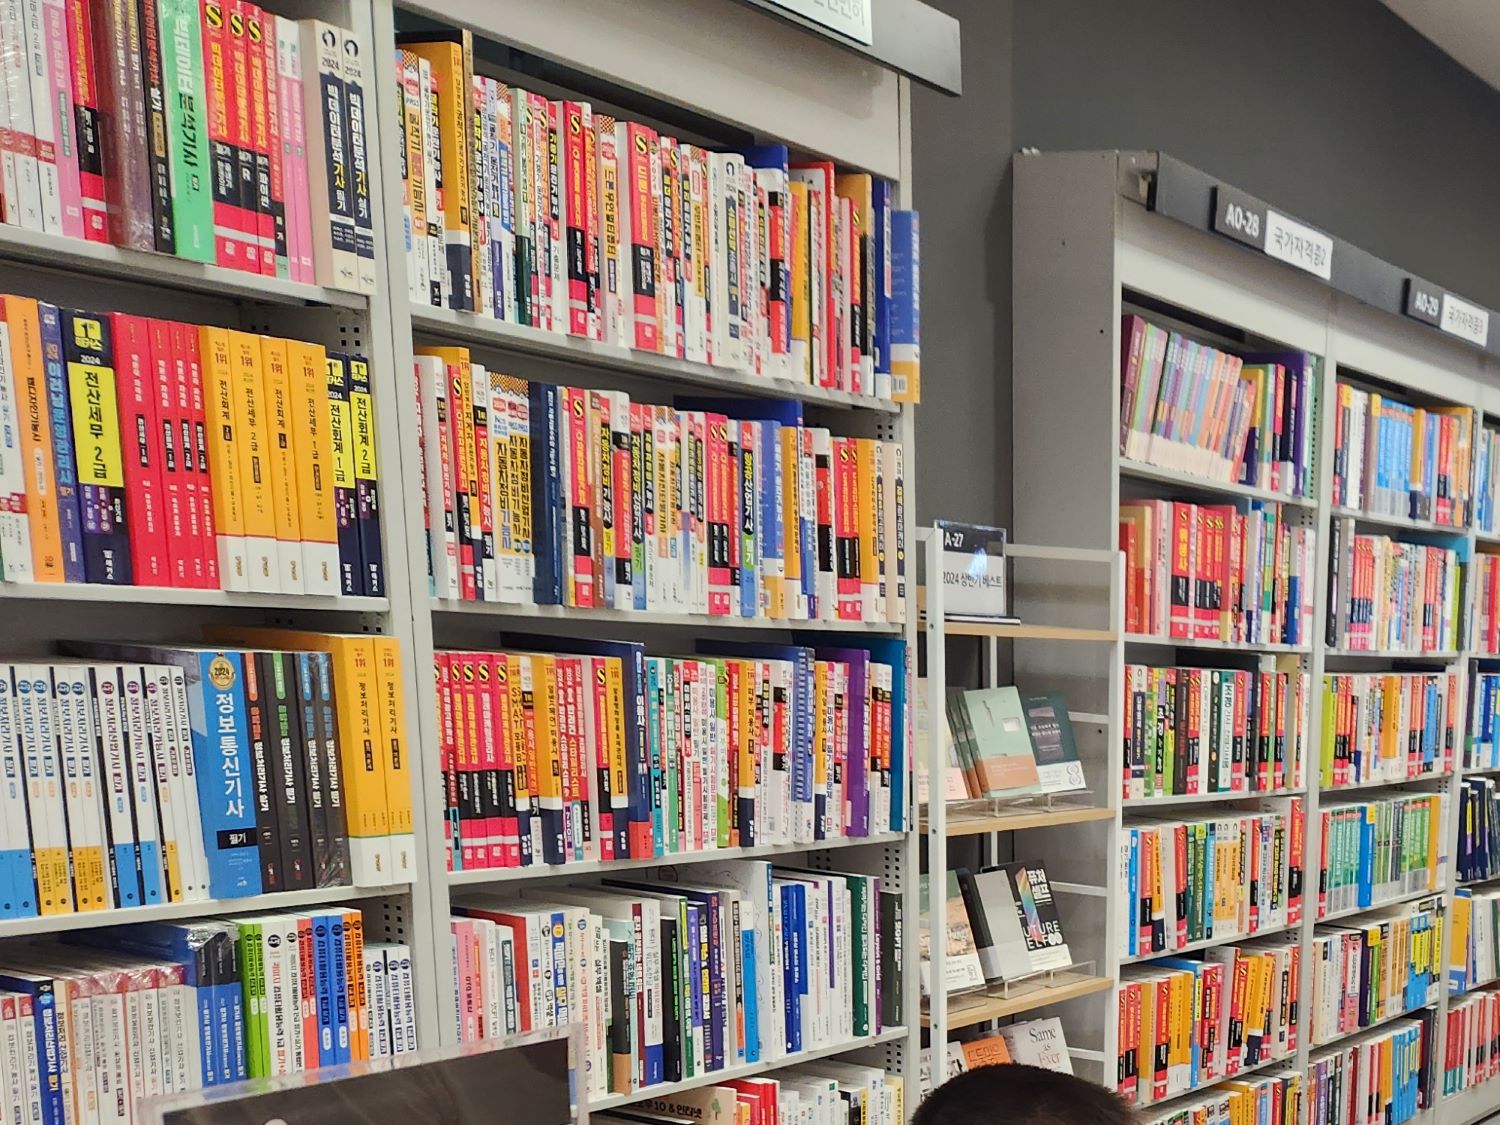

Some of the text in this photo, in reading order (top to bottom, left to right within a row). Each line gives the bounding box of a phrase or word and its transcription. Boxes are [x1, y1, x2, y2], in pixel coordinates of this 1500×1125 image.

[322, 57, 340, 70] 2024
[326, 84, 346, 189] 빅데이터분석기사
[349, 94, 367, 197] 빅데이터분석기사
[219, 379, 231, 419] 전산회계
[245, 388, 257, 427] 전산세무
[274, 389, 286, 429] 전산회계
[84, 371, 107, 479] 전산세무 2급
[330, 404, 347, 483] 전산회계 1급
[356, 397, 373, 475] 전산회계 2급
[961, 573, 982, 588] 상반기
[982, 575, 1003, 588] 베스트
[358, 682, 370, 735] 정보처리기사
[386, 681, 398, 734] 정보처리기사
[216, 693, 245, 819] 정보통신기사
[254, 741, 267, 794] 정보처리기사
[281, 737, 293, 786] 정보처리기사
[308, 739, 320, 789] 정보처리기사
[326, 739, 338, 789] 정보처리기사
[228, 832, 247, 845] 필기
[1027, 869, 1046, 884] 퓨처
[1023, 920, 1061, 938] UTURE
[1029, 1025, 1057, 1043] Same
